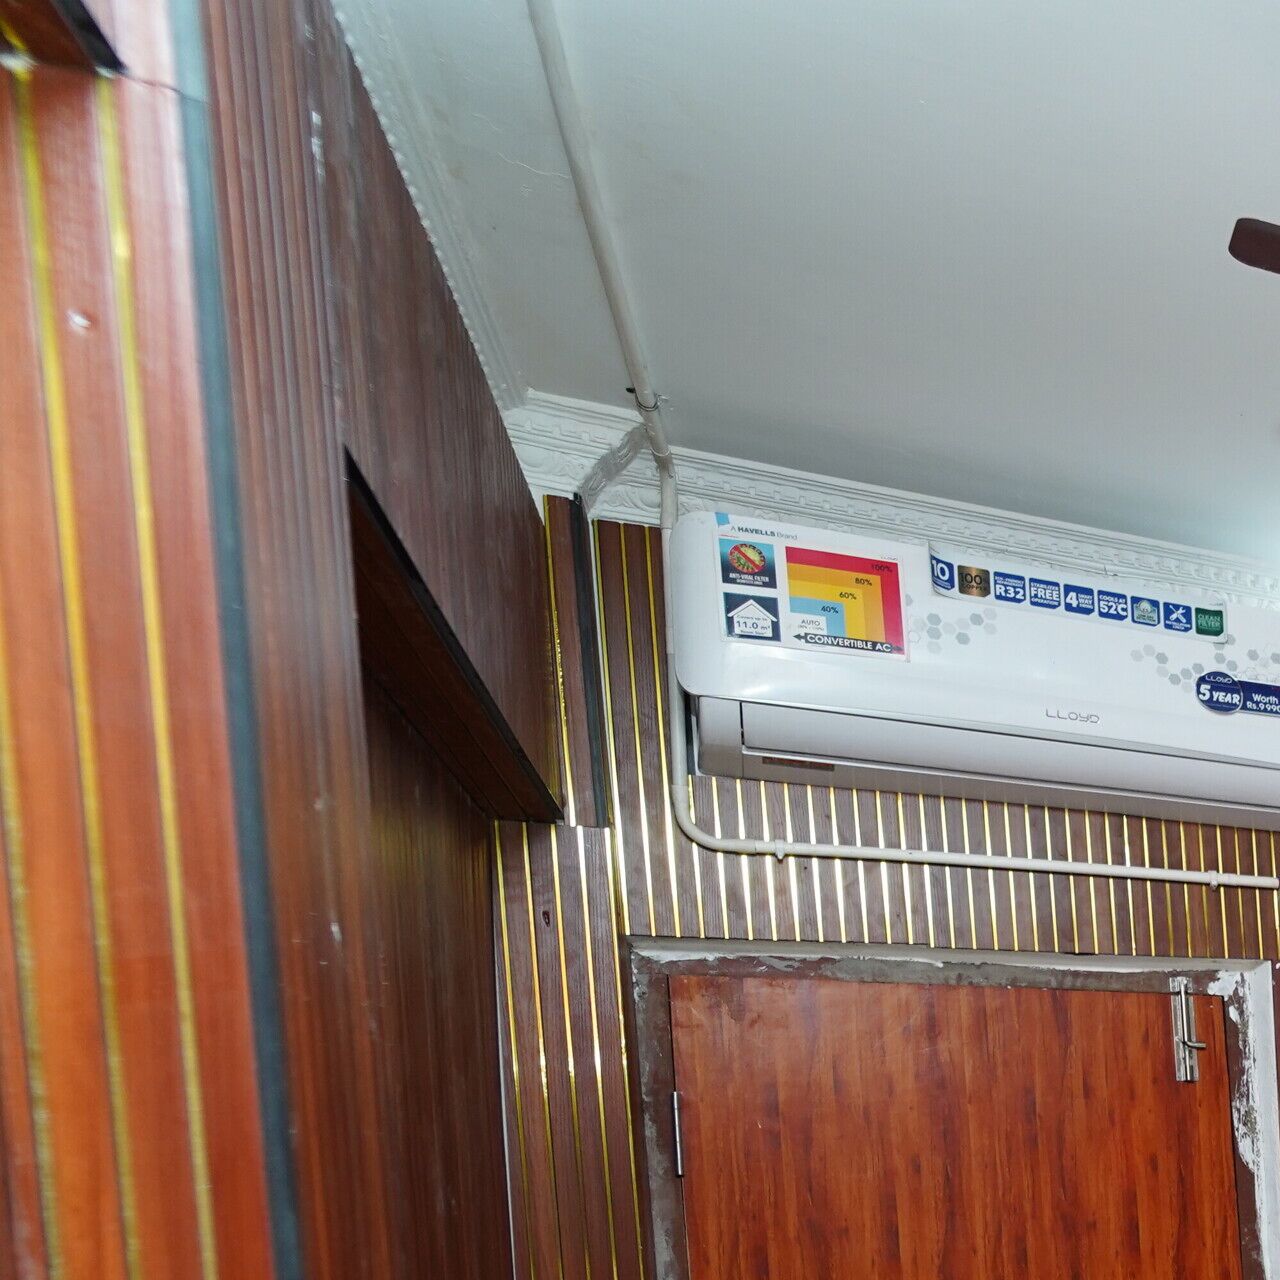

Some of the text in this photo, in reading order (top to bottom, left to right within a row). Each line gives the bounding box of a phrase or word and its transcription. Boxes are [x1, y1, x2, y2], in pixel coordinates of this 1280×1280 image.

[737, 526, 775, 537] HAVELLS
[777, 531, 798, 541] Brand
[871, 564, 893, 573] 100%
[931, 559, 950, 581] 10
[855, 577, 873, 587] 80%
[839, 591, 857, 600] 60%
[995, 584, 1025, 600] R32
[1031, 587, 1060, 601] FREE
[1065, 591, 1078, 608] 4
[1099, 594, 1118, 603] COOLS
[821, 605, 839, 614] 40%
[736, 620, 760, 630] 11.0
[801, 619, 821, 627] AUTO
[806, 634, 892, 652] CONVERTIBLE AC
[1205, 675, 1233, 684] LLOYD
[1198, 684, 1240, 705] 5 YEAR
[1252, 693, 1279, 705] Worth
[1045, 708, 1100, 724] LLOYD
